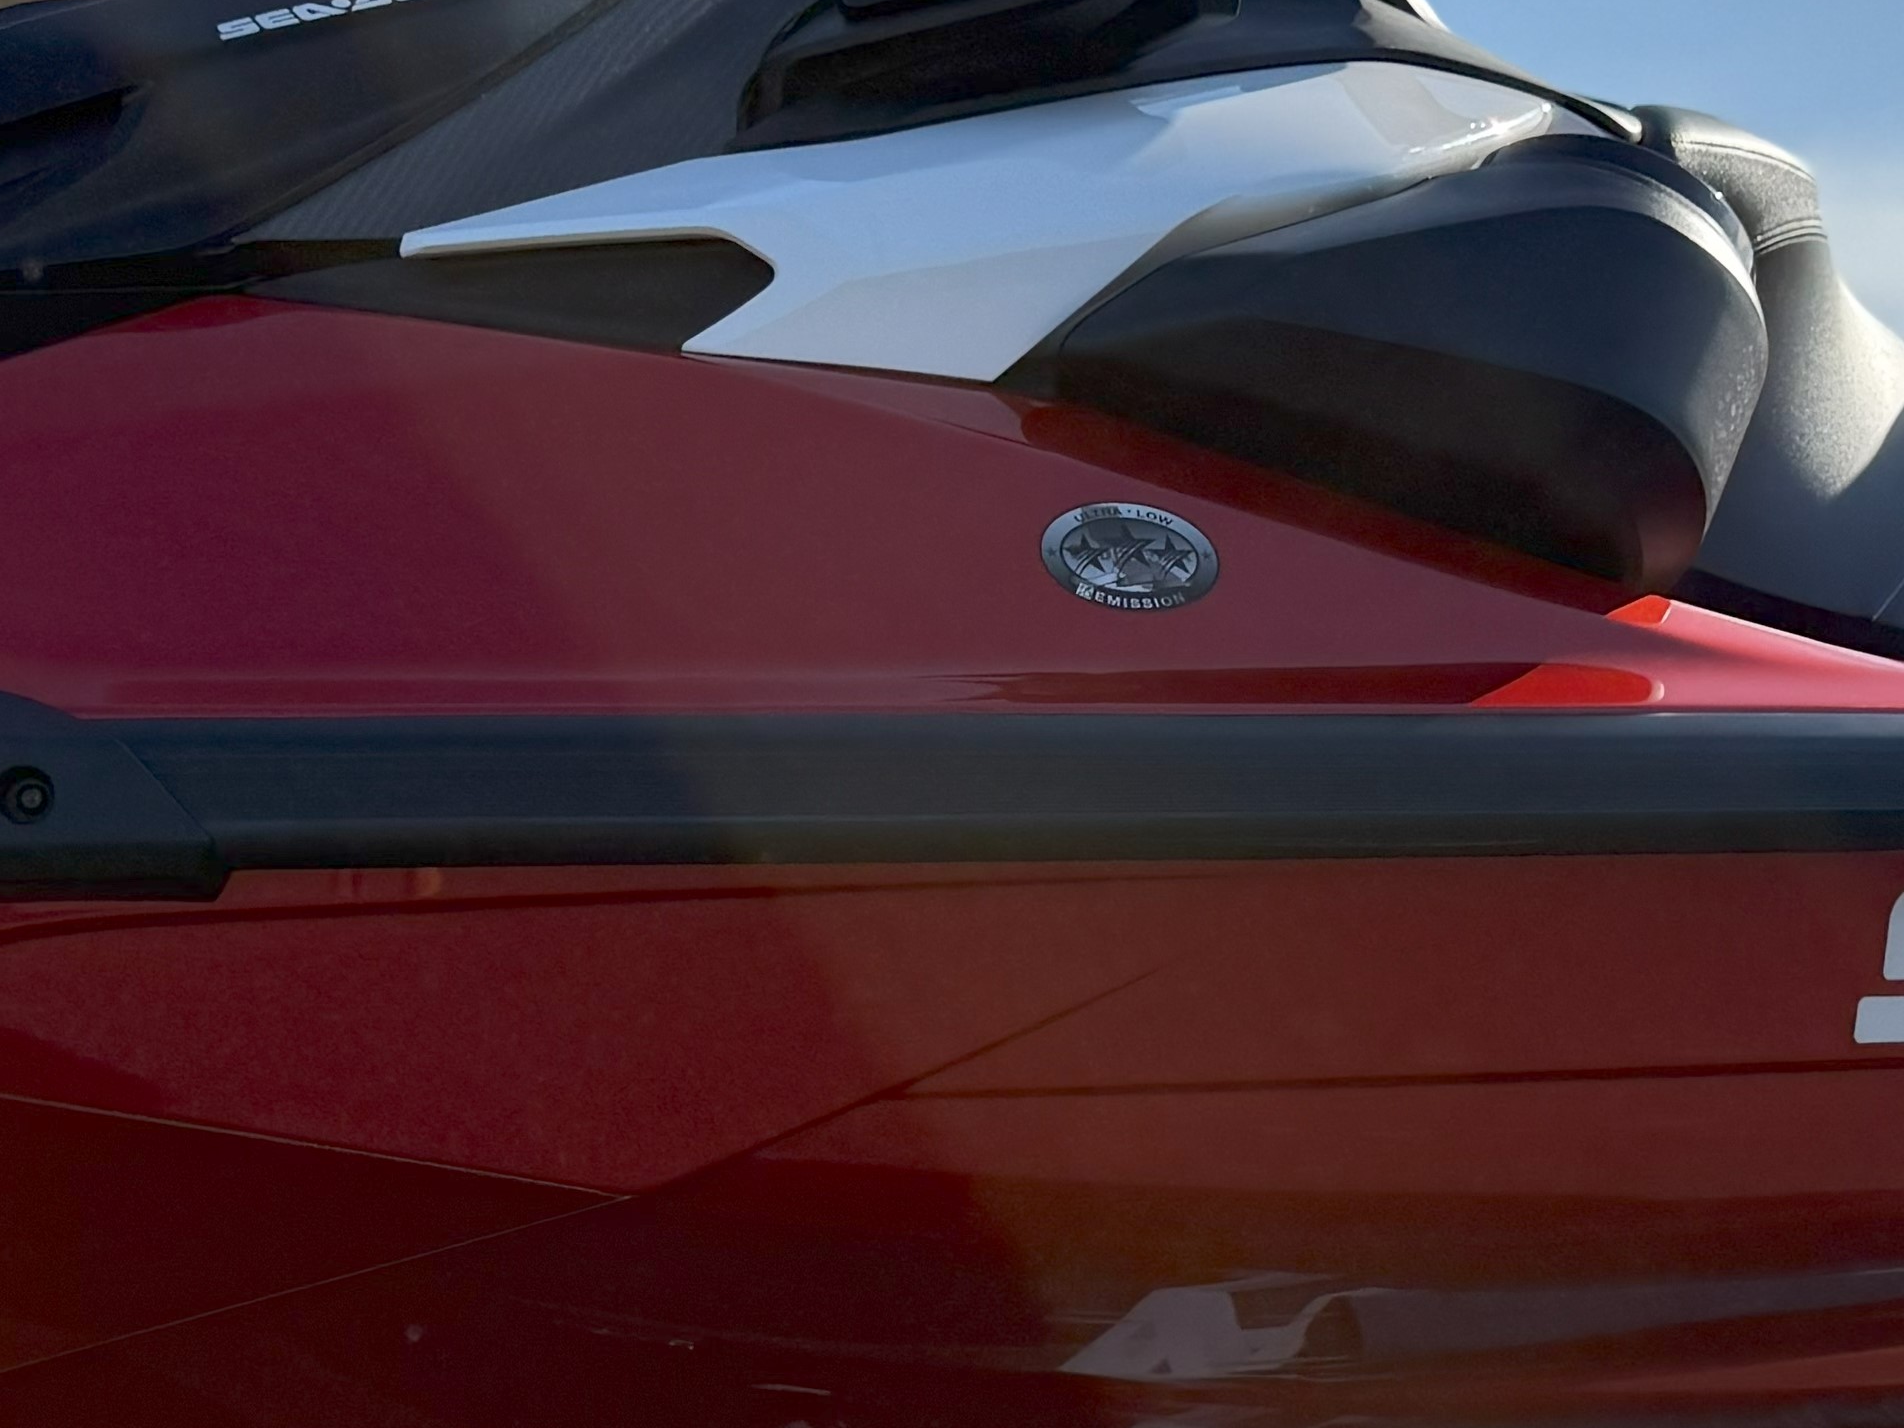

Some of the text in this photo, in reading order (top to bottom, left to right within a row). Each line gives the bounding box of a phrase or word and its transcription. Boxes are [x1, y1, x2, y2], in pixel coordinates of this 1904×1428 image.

[1073, 505, 1174, 526] ULTRA LOW
[1094, 590, 1186, 609] EMISSION
